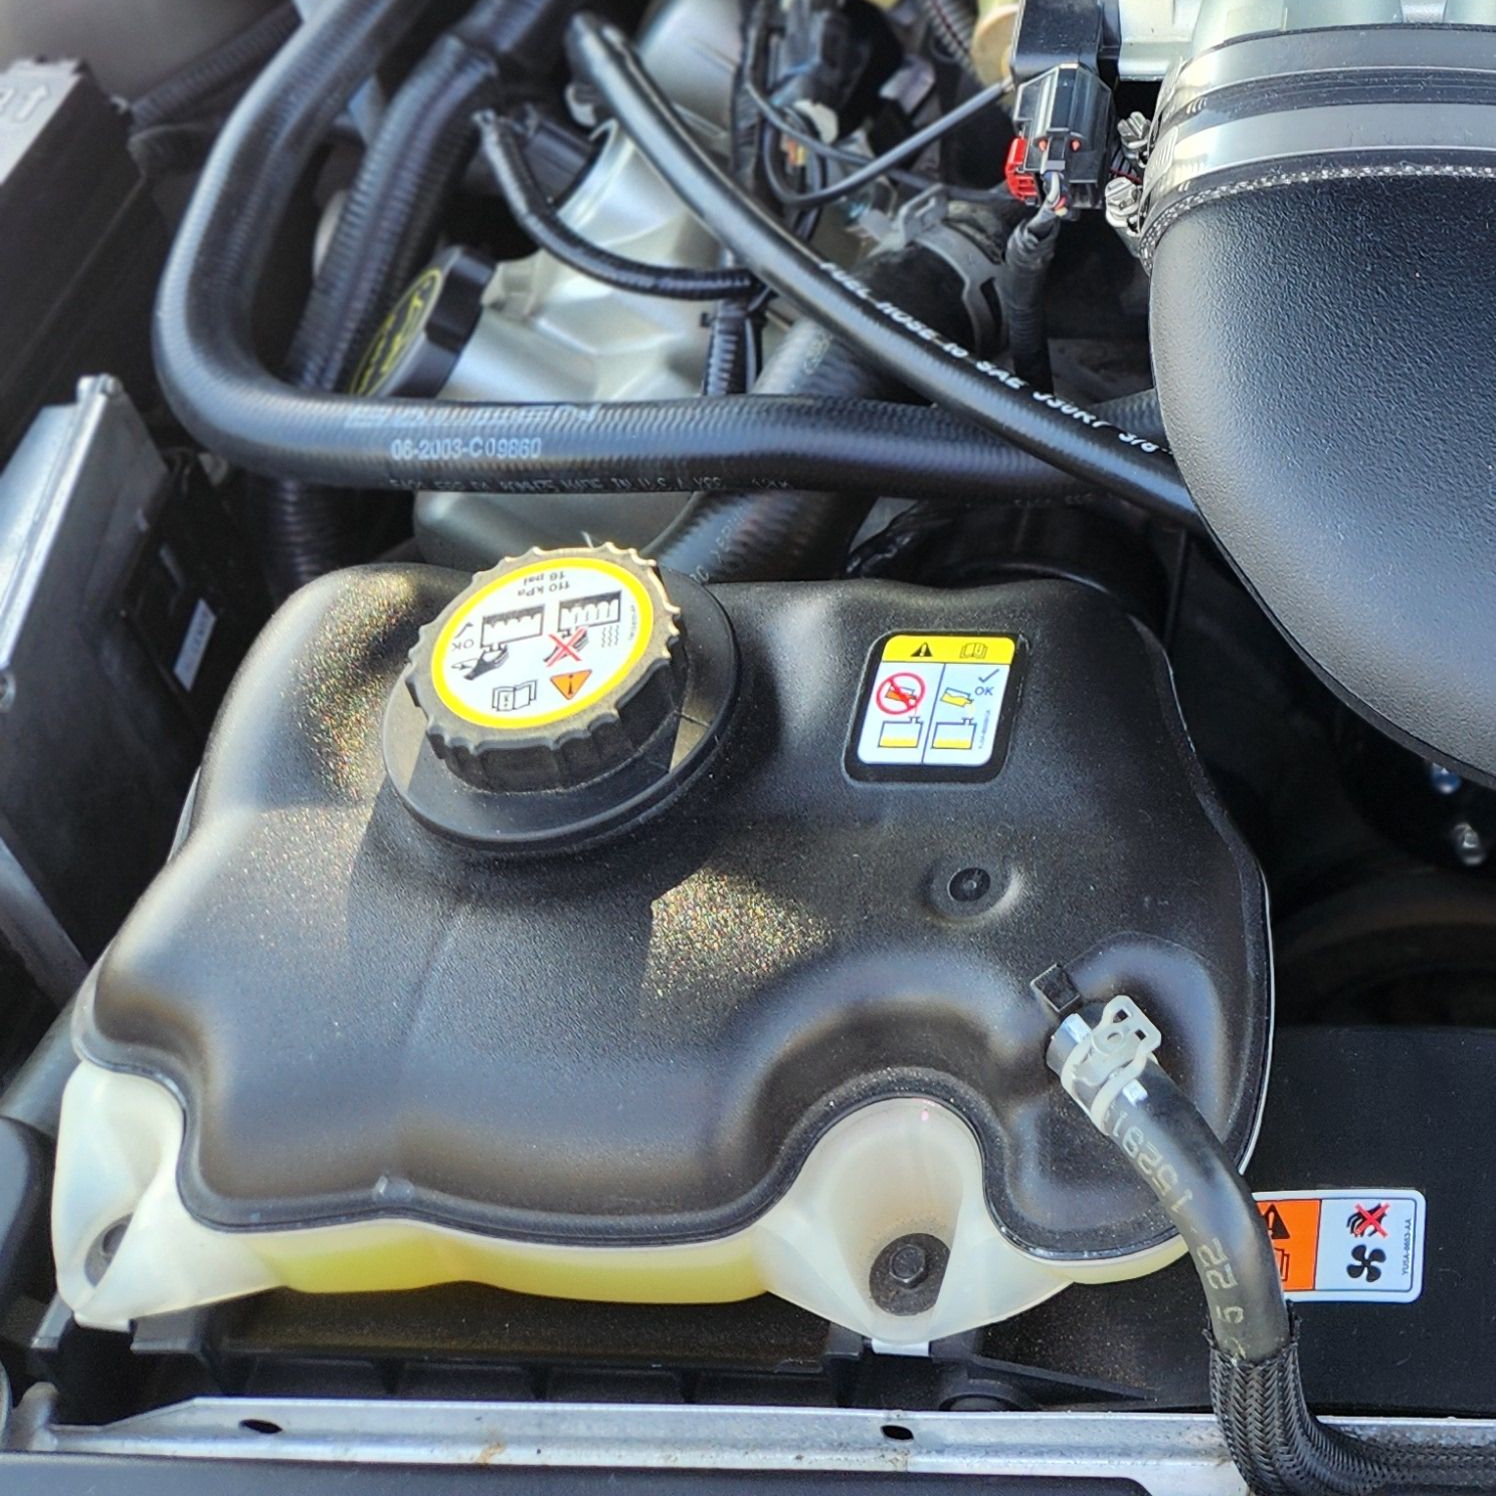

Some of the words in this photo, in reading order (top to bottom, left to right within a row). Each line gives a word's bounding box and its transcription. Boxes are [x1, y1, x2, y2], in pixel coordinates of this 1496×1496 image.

[819, 261, 872, 299] FUEL
[875, 301, 940, 340] HOSE
[975, 360, 1029, 390] SAE
[450, 638, 474, 652] OK
[974, 686, 994, 696] OK
